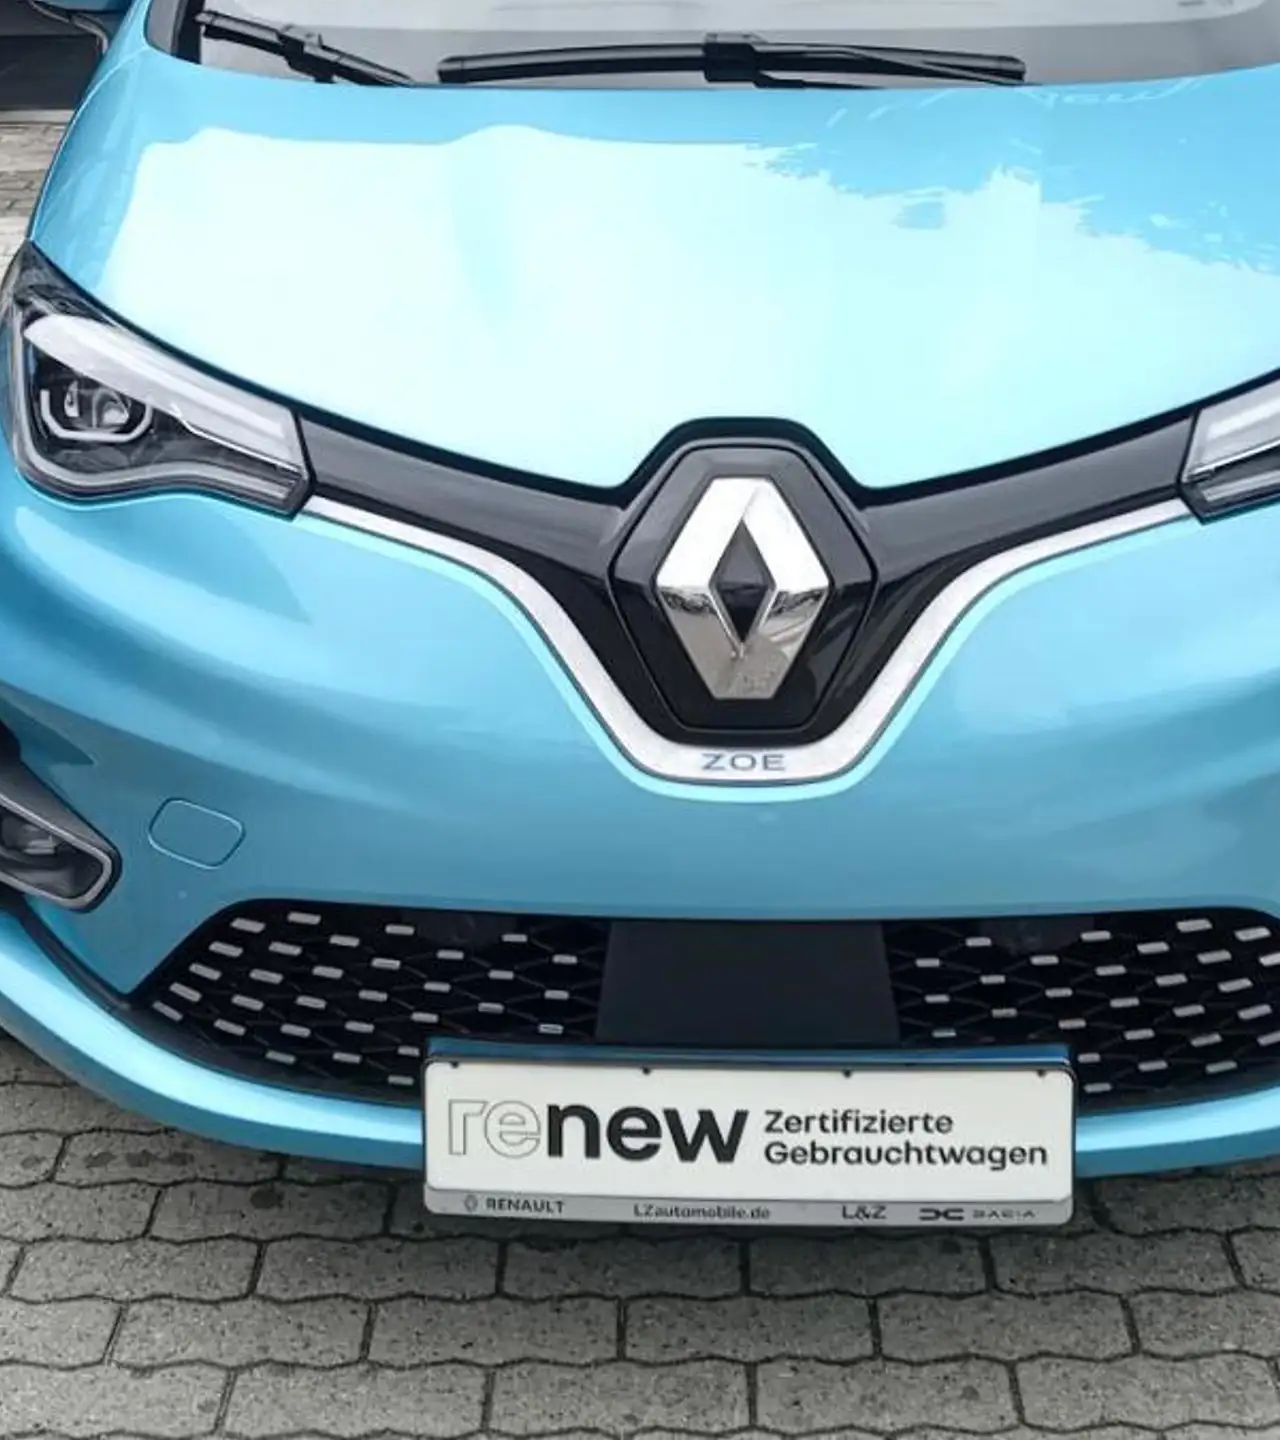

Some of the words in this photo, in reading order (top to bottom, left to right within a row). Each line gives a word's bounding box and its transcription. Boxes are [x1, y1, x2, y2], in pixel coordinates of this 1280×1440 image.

[701, 752, 787, 772] ZOE
[448, 1098, 749, 1164] renew
[764, 1109, 955, 1136] Zertifizierte
[764, 1141, 1048, 1171] Gebrauchtwagen
[485, 1197, 565, 1214] RENAULT
[633, 1203, 771, 1220] LZautomobile.de
[841, 1204, 887, 1221] L&Z
